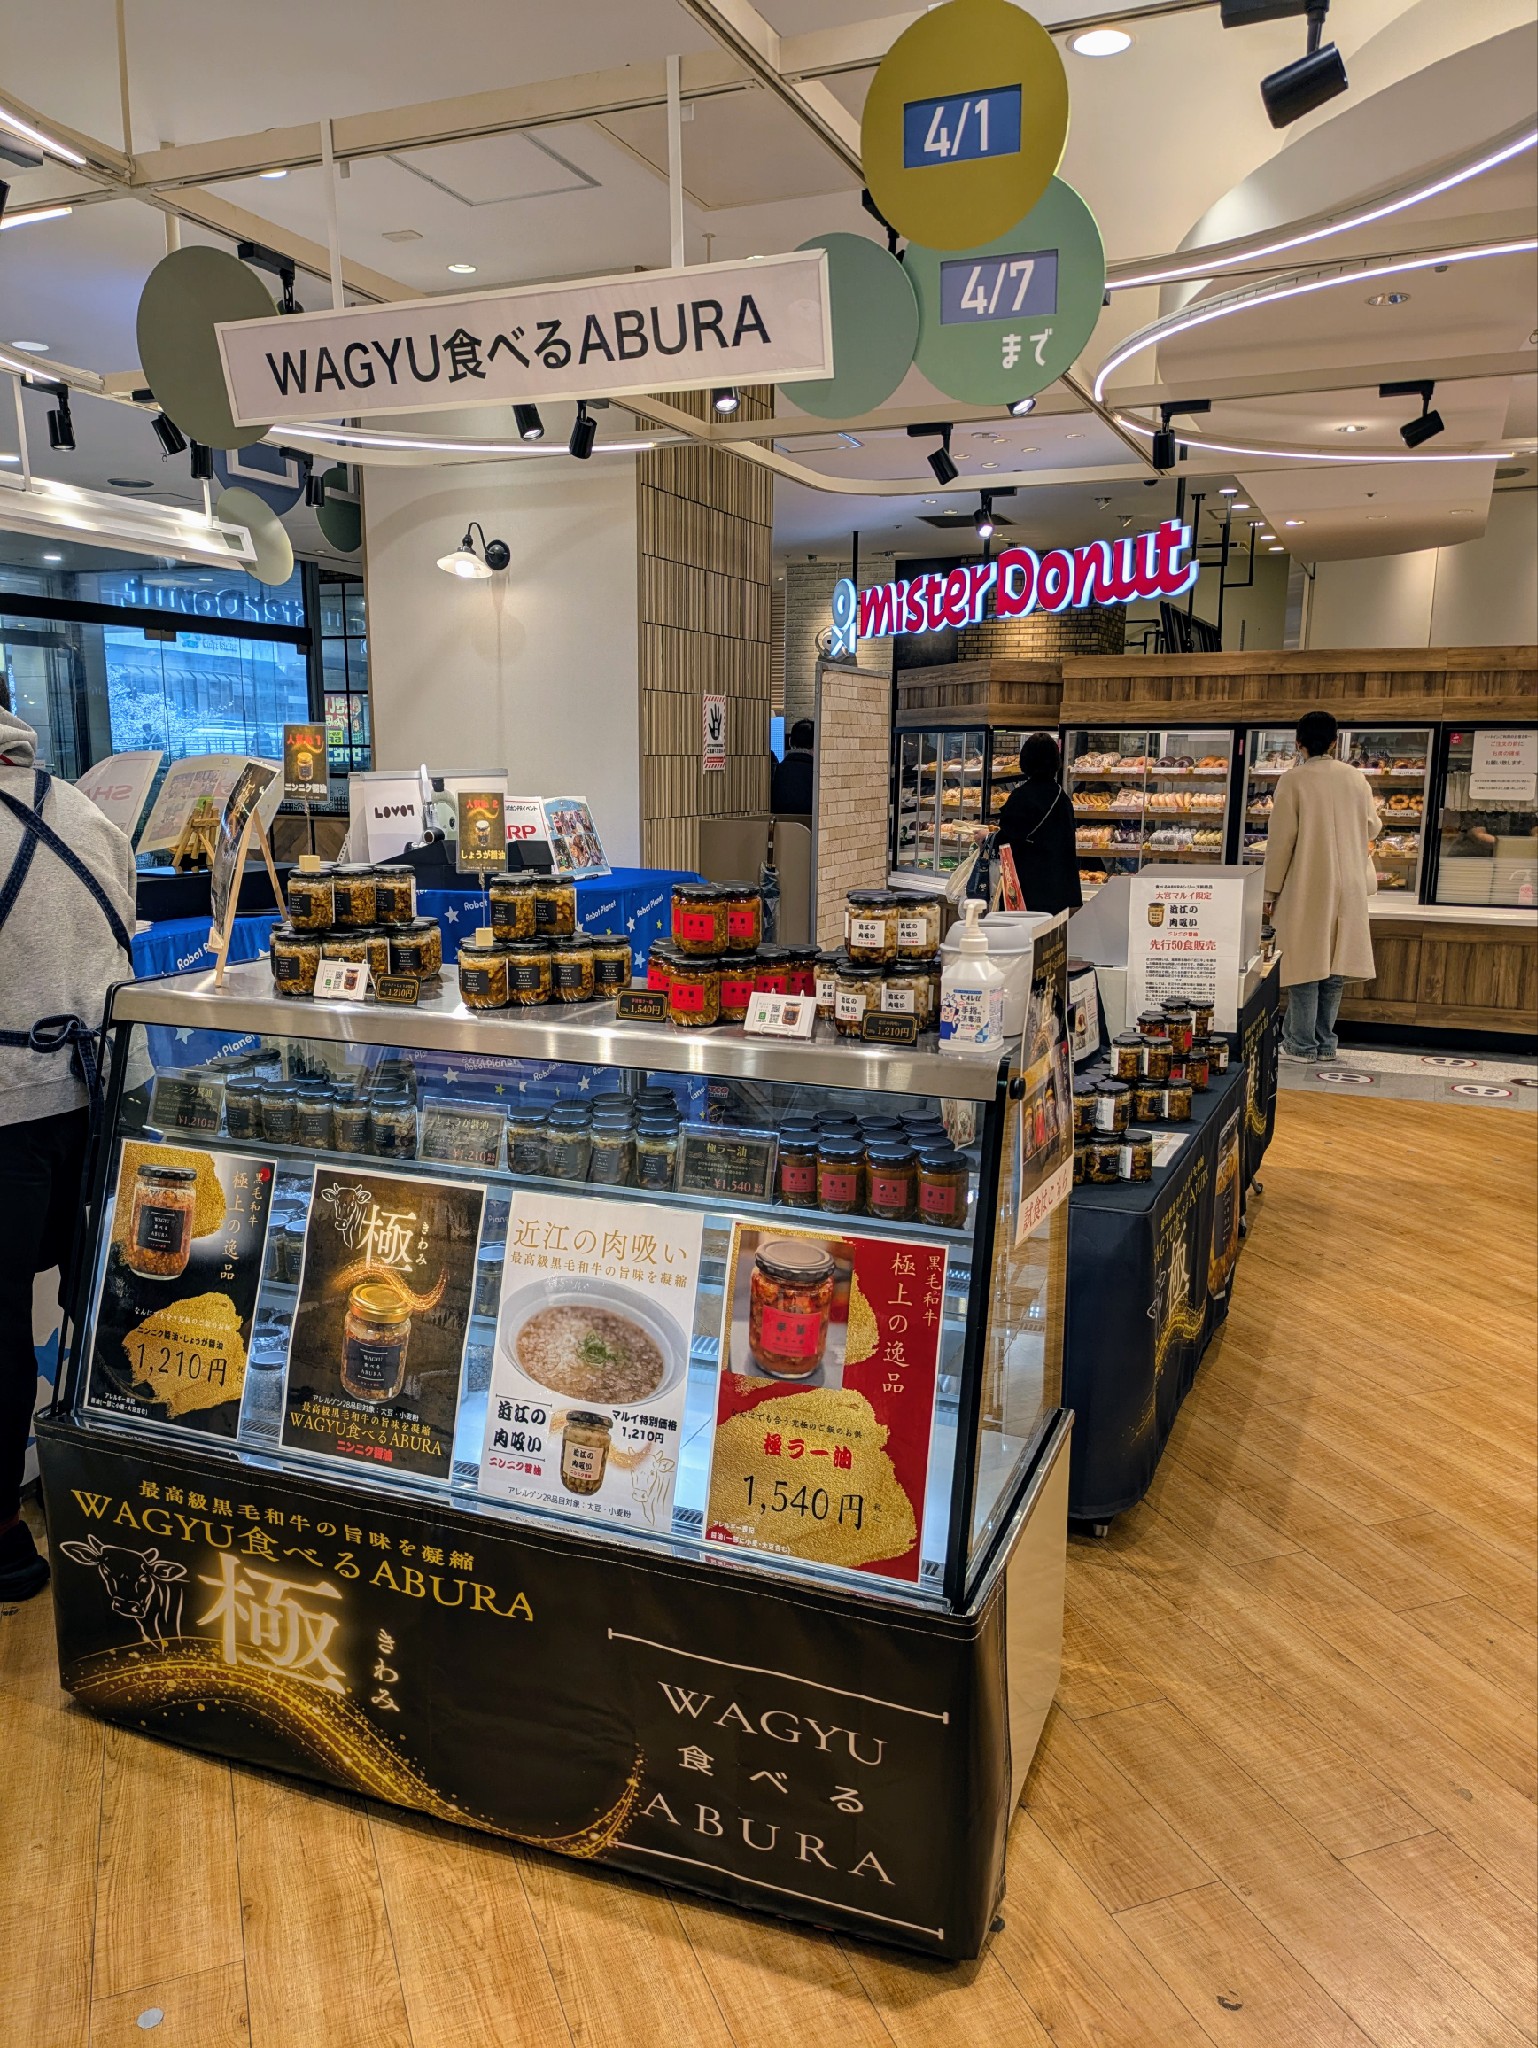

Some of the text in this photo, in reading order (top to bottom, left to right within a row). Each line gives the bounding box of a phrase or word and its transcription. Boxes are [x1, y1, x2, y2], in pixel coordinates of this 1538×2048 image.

[924, 98, 989, 157] 4/1
[960, 259, 1035, 315] 4/7
[266, 294, 772, 397] WAGYU食べるABURA
[1001, 328, 1053, 369] まで
[996, 518, 1200, 619] Donut
[461, 849, 506, 860] しょうが醤油
[1155, 891, 1212, 900] 大宮マルイ限定
[176, 946, 204, 971] Robot
[1150, 939, 1217, 951] 先行50食販売
[631, 1004, 661, 1015] 1,540円
[706, 1142, 748, 1157] 極ラー油
[248, 1172, 265, 1227] 黒毛和牛
[220, 1170, 249, 1281] 極上の逸品
[355, 1204, 417, 1273] 極
[415, 1221, 428, 1265] きわみ
[513, 1218, 688, 1266] 近江の肉吸い
[510, 1250, 688, 1289] 最高級黒毛和牛の旨味を凝縮
[922, 1255, 942, 1327] 黒毛和牛
[882, 1252, 916, 1393] 極上の逸品
[137, 1343, 227, 1387] 1,210円
[302, 1401, 432, 1437] 最高級黒毛和牛の旨味を凝縮
[497, 1400, 547, 1425] 近江の
[611, 1409, 678, 1432] マルイ特別価格
[336, 1440, 393, 1462] ニンニク醤油
[493, 1427, 542, 1453] 肉吸い
[621, 1426, 664, 1444] 1,210円
[763, 1432, 853, 1470] 極ラー油
[488, 1456, 542, 1477] ニンニク醤油
[743, 1475, 864, 1531] 1,540円
[138, 1479, 475, 1572] 最高級黒毛和牛の旨味を凝縮
[197, 1551, 347, 1696] 極
[371, 1628, 400, 1712] きわみ
[657, 1680, 888, 1767] WAGYU
[639, 1792, 897, 1887] ABURA
